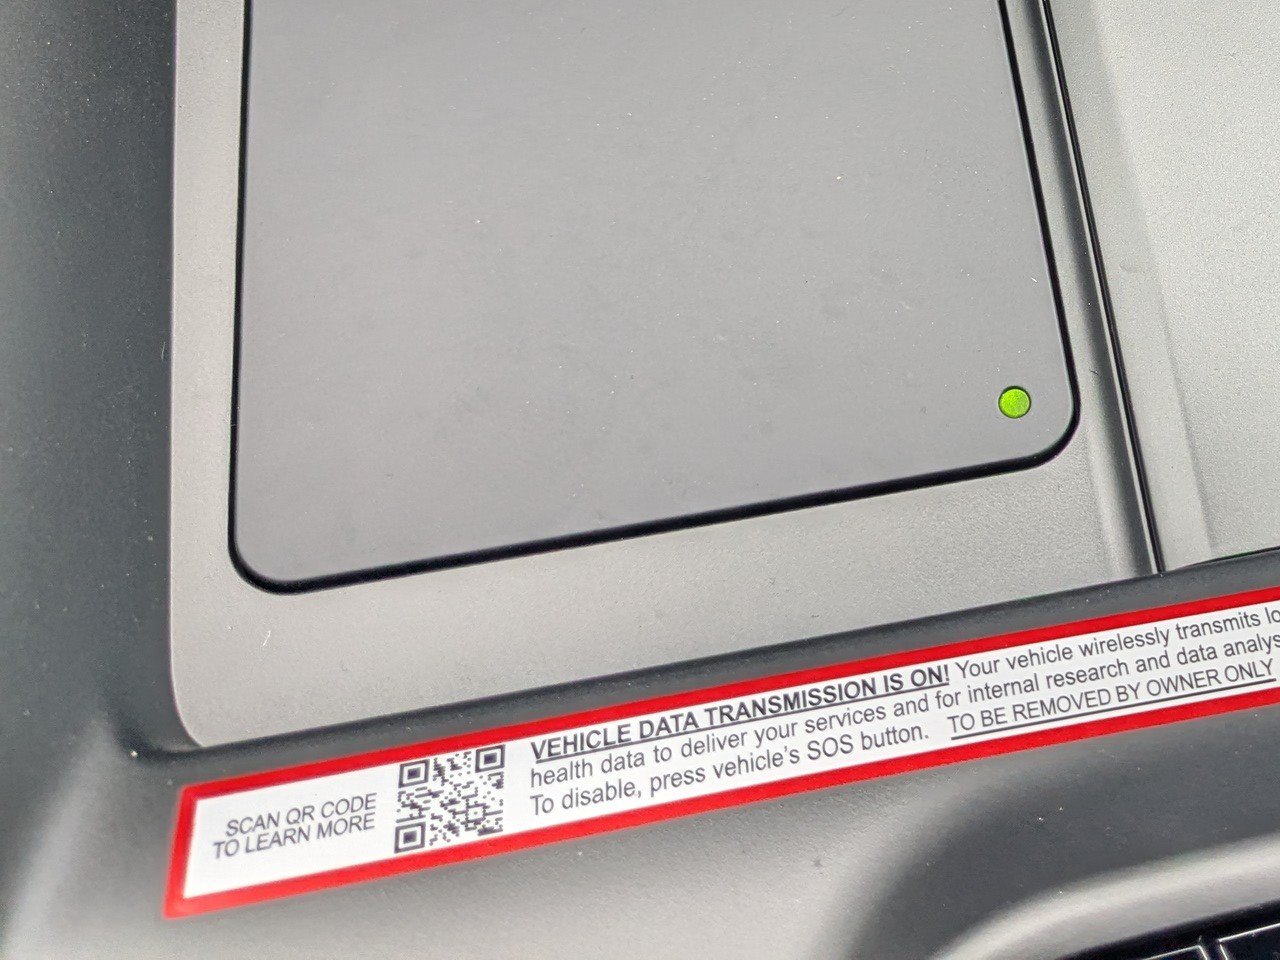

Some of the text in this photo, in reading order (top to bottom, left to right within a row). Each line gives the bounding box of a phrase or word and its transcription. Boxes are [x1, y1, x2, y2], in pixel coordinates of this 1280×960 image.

[529, 794, 554, 816] To
[561, 778, 641, 810] disable,
[650, 767, 706, 798] press
[807, 733, 854, 761] SOS
[860, 725, 929, 751] button.
[946, 713, 976, 733] TO
[980, 706, 1008, 728] BE
[1012, 688, 1112, 722] REMOVED
[1115, 681, 1141, 703] BY
[1146, 668, 1222, 697] OWNER
[1224, 657, 1273, 683] ONLY
[530, 723, 632, 760] VEHICLE
[639, 711, 702, 740] DATA
[704, 677, 877, 726] TRANSMISSION
[882, 672, 904, 693] IS
[910, 664, 950, 688] ON!
[955, 659, 1001, 679] Your
[1005, 644, 1073, 670] vehicle
[1078, 626, 1170, 657] wirelessly
[1175, 611, 1261, 640] transmits
[530, 758, 593, 788] health
[601, 750, 645, 774] data
[653, 745, 672, 764] to
[680, 731, 748, 758] deliver
[753, 722, 798, 749] your
[804, 705, 887, 734] services
[893, 693, 930, 718] and
[934, 690, 962, 709] for
[967, 672, 1040, 704] internal
[1045, 658, 1130, 689] research
[1135, 649, 1171, 673] and
[1176, 644, 1219, 666] data
[214, 812, 375, 858] TO LEARN MORE
[225, 792, 377, 837] SCAN QR CODE
